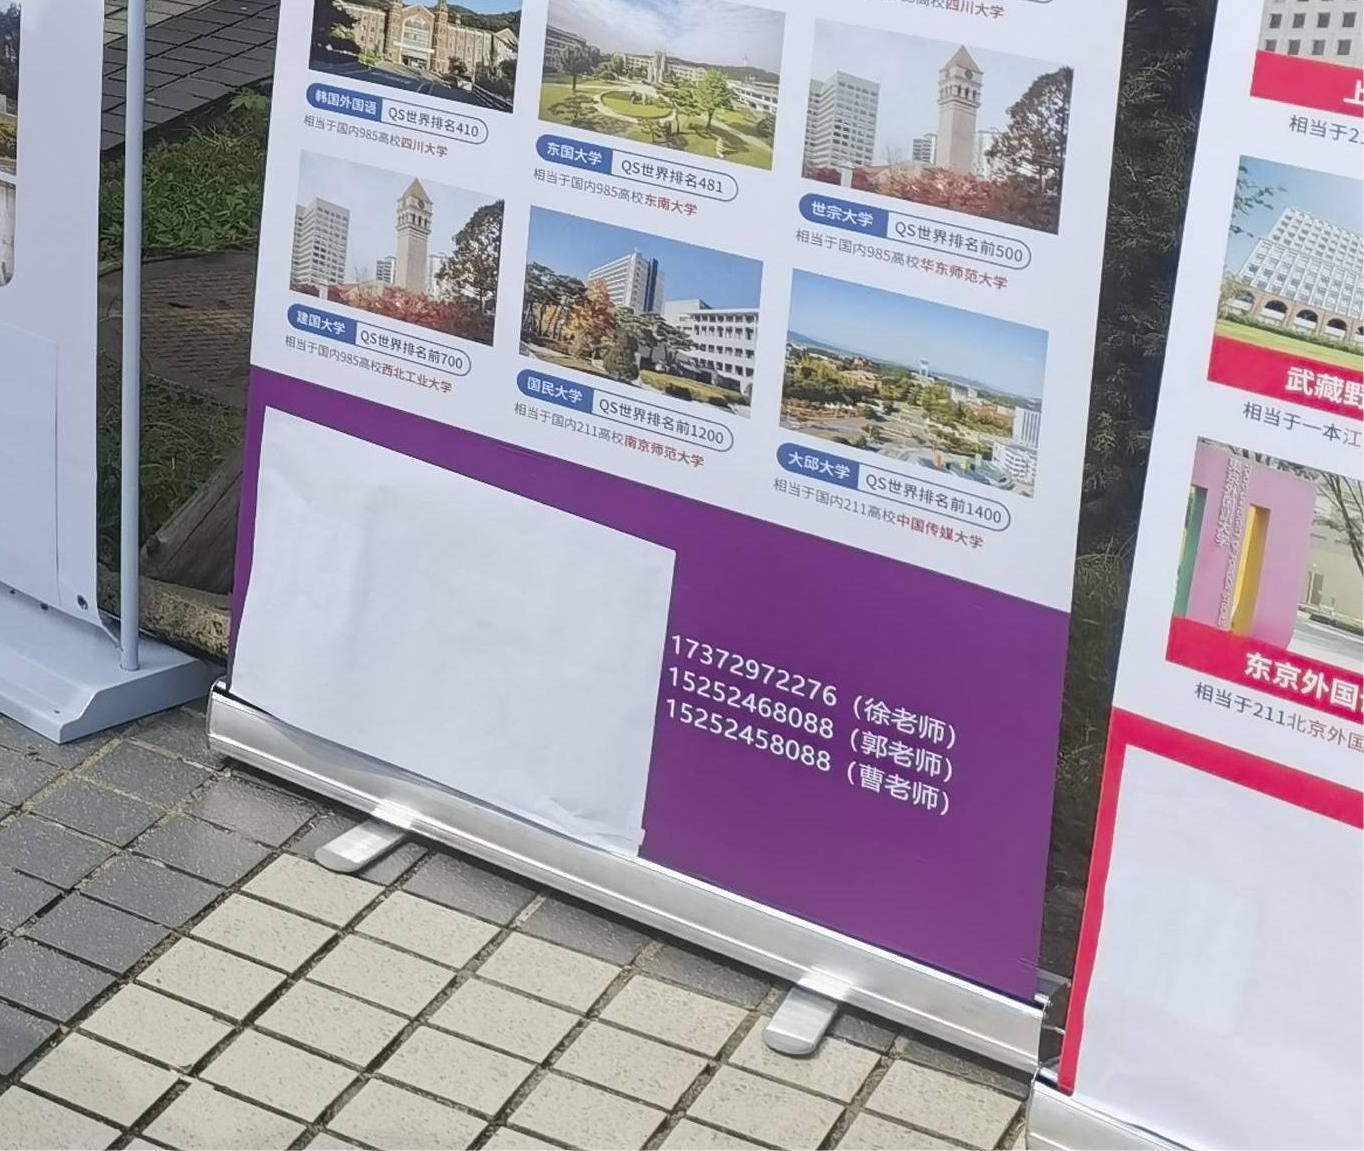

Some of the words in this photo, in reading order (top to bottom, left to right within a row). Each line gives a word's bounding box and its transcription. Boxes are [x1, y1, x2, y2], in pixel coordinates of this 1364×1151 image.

[303, 114, 449, 158] 相当于国内985高校四川大学
[314, 88, 377, 116] 韩国外国语
[388, 106, 480, 139] QS世界排名410
[1288, 114, 1364, 145] 相当于2
[532, 167, 698, 217] 相当于国内985高校东南大学
[546, 140, 602, 166] 东国大学
[621, 158, 724, 195] QS世界排名481
[794, 227, 1009, 291] 相当于国内985高校华东师范大学
[811, 199, 874, 229] 世宗大学
[894, 219, 1024, 264] QS世界排名前500
[285, 335, 454, 394] 相当于国内985高校西北工业大学
[296, 310, 346, 335] 建国大学
[360, 329, 464, 370] QS世界排名前700
[513, 400, 705, 468] 相当于国内211高校南京师范大学
[526, 375, 583, 404] 国民大学
[598, 398, 724, 445] QS世界排名前1200
[1241, 401, 1362, 448] 相当于一本江
[773, 476, 985, 550] 相当于国内211高校中国传媒大学
[788, 450, 851, 481] 大邱大学
[865, 472, 1003, 526] QS世界排名前1400
[671, 634, 956, 750] 17372972276（徐老师）
[1244, 652, 1364, 714] 东京外国
[669, 666, 954, 783] 15252468088（郭老师）
[1194, 681, 1364, 753] 相当于211北京外国
[666, 698, 951, 816] 15252458088（曹老师）
